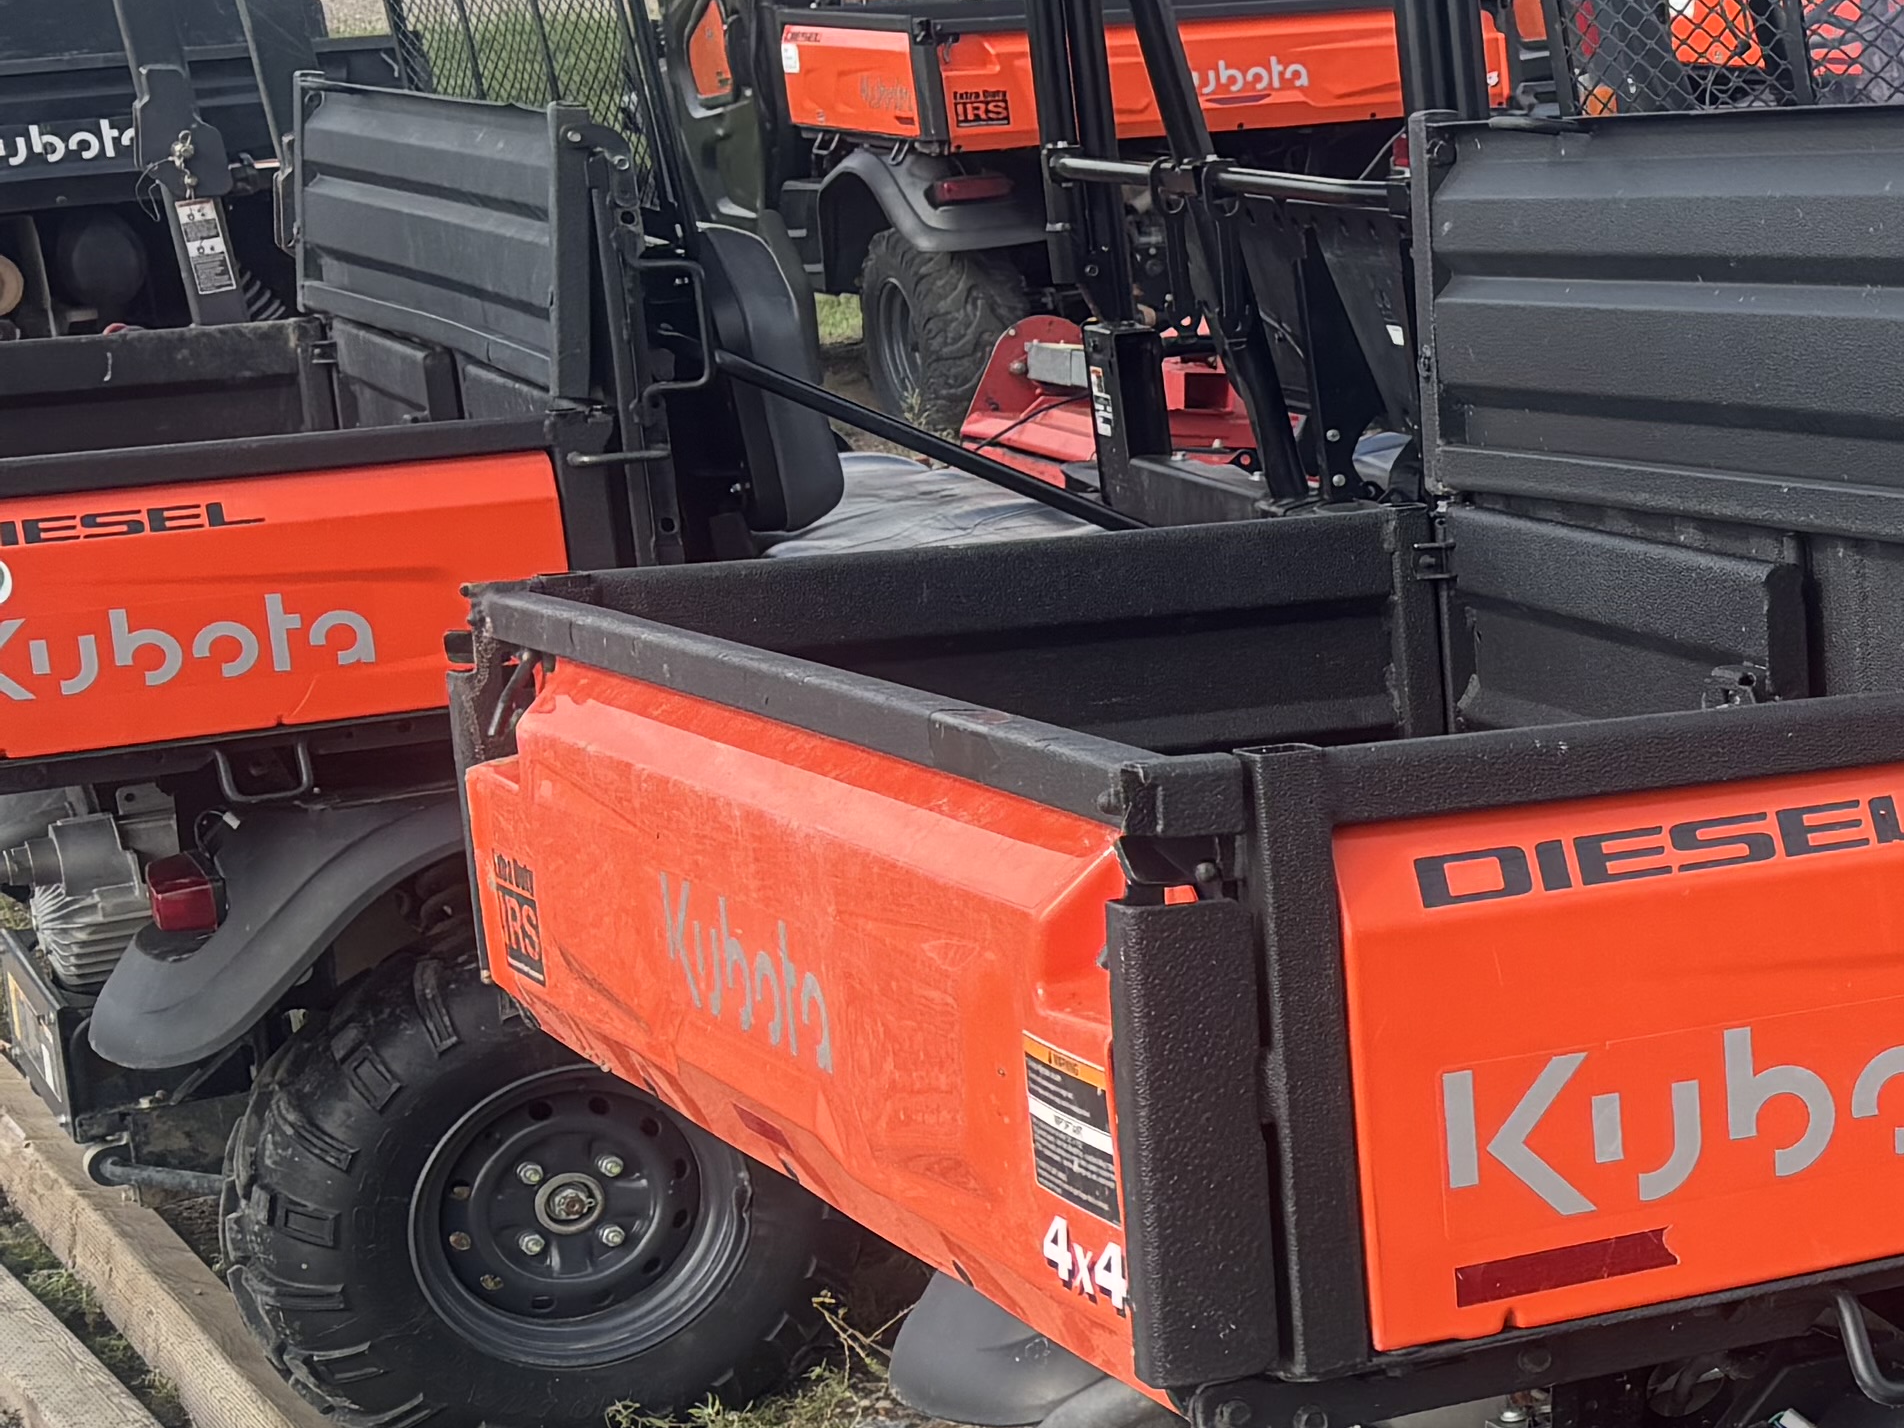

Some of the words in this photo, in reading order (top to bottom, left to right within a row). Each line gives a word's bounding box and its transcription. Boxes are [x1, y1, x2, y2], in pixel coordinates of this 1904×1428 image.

[1191, 56, 1309, 94] ubota
[956, 101, 1009, 122] IRS
[500, 890, 540, 961] IRS
[659, 870, 833, 1074] Kubota
[1043, 1215, 1129, 1316] 4x4
